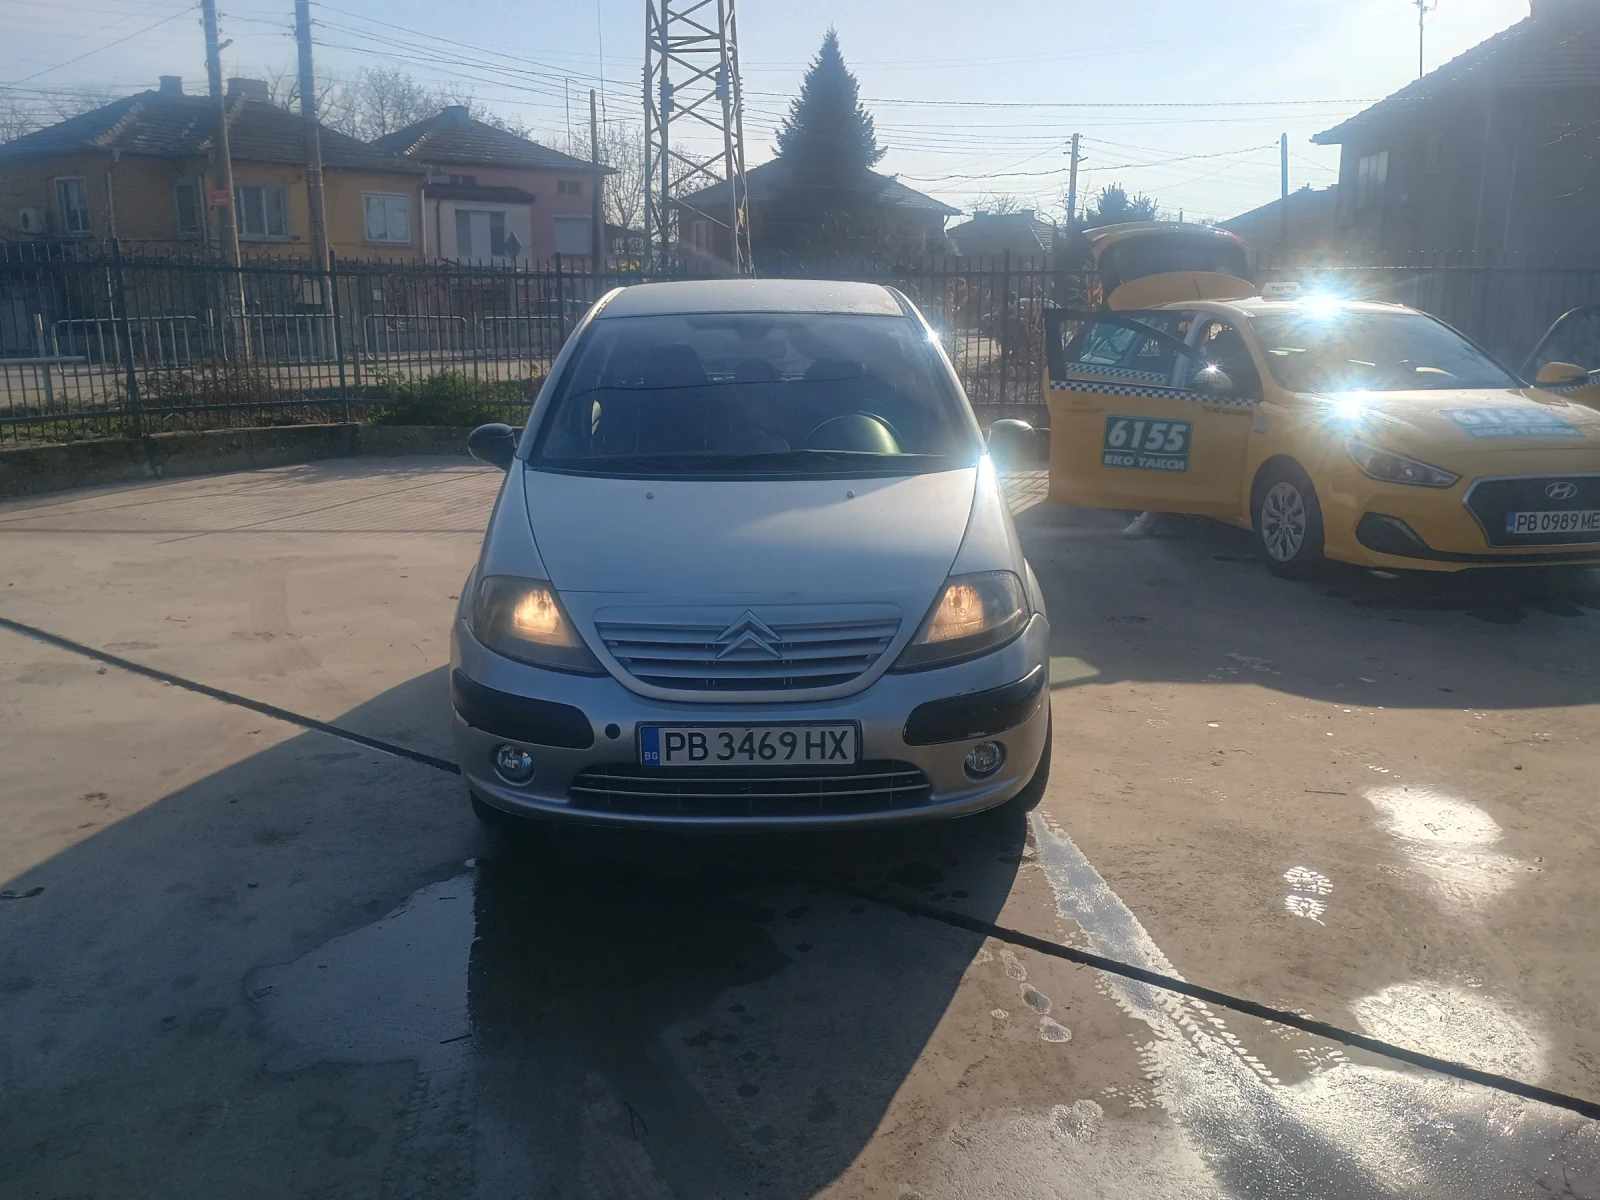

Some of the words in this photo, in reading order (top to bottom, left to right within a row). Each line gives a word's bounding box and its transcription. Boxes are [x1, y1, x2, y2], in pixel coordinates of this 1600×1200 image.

[1108, 420, 1188, 452] 6155
[1103, 454, 1135, 466] ЕКО
[1137, 457, 1186, 471] ТАКСИ
[1516, 514, 1538, 532] PB
[1541, 513, 1579, 531] 0989
[664, 731, 709, 762] PB
[716, 731, 798, 761] 3469
[805, 730, 848, 760] HX
[644, 751, 659, 761] BG
